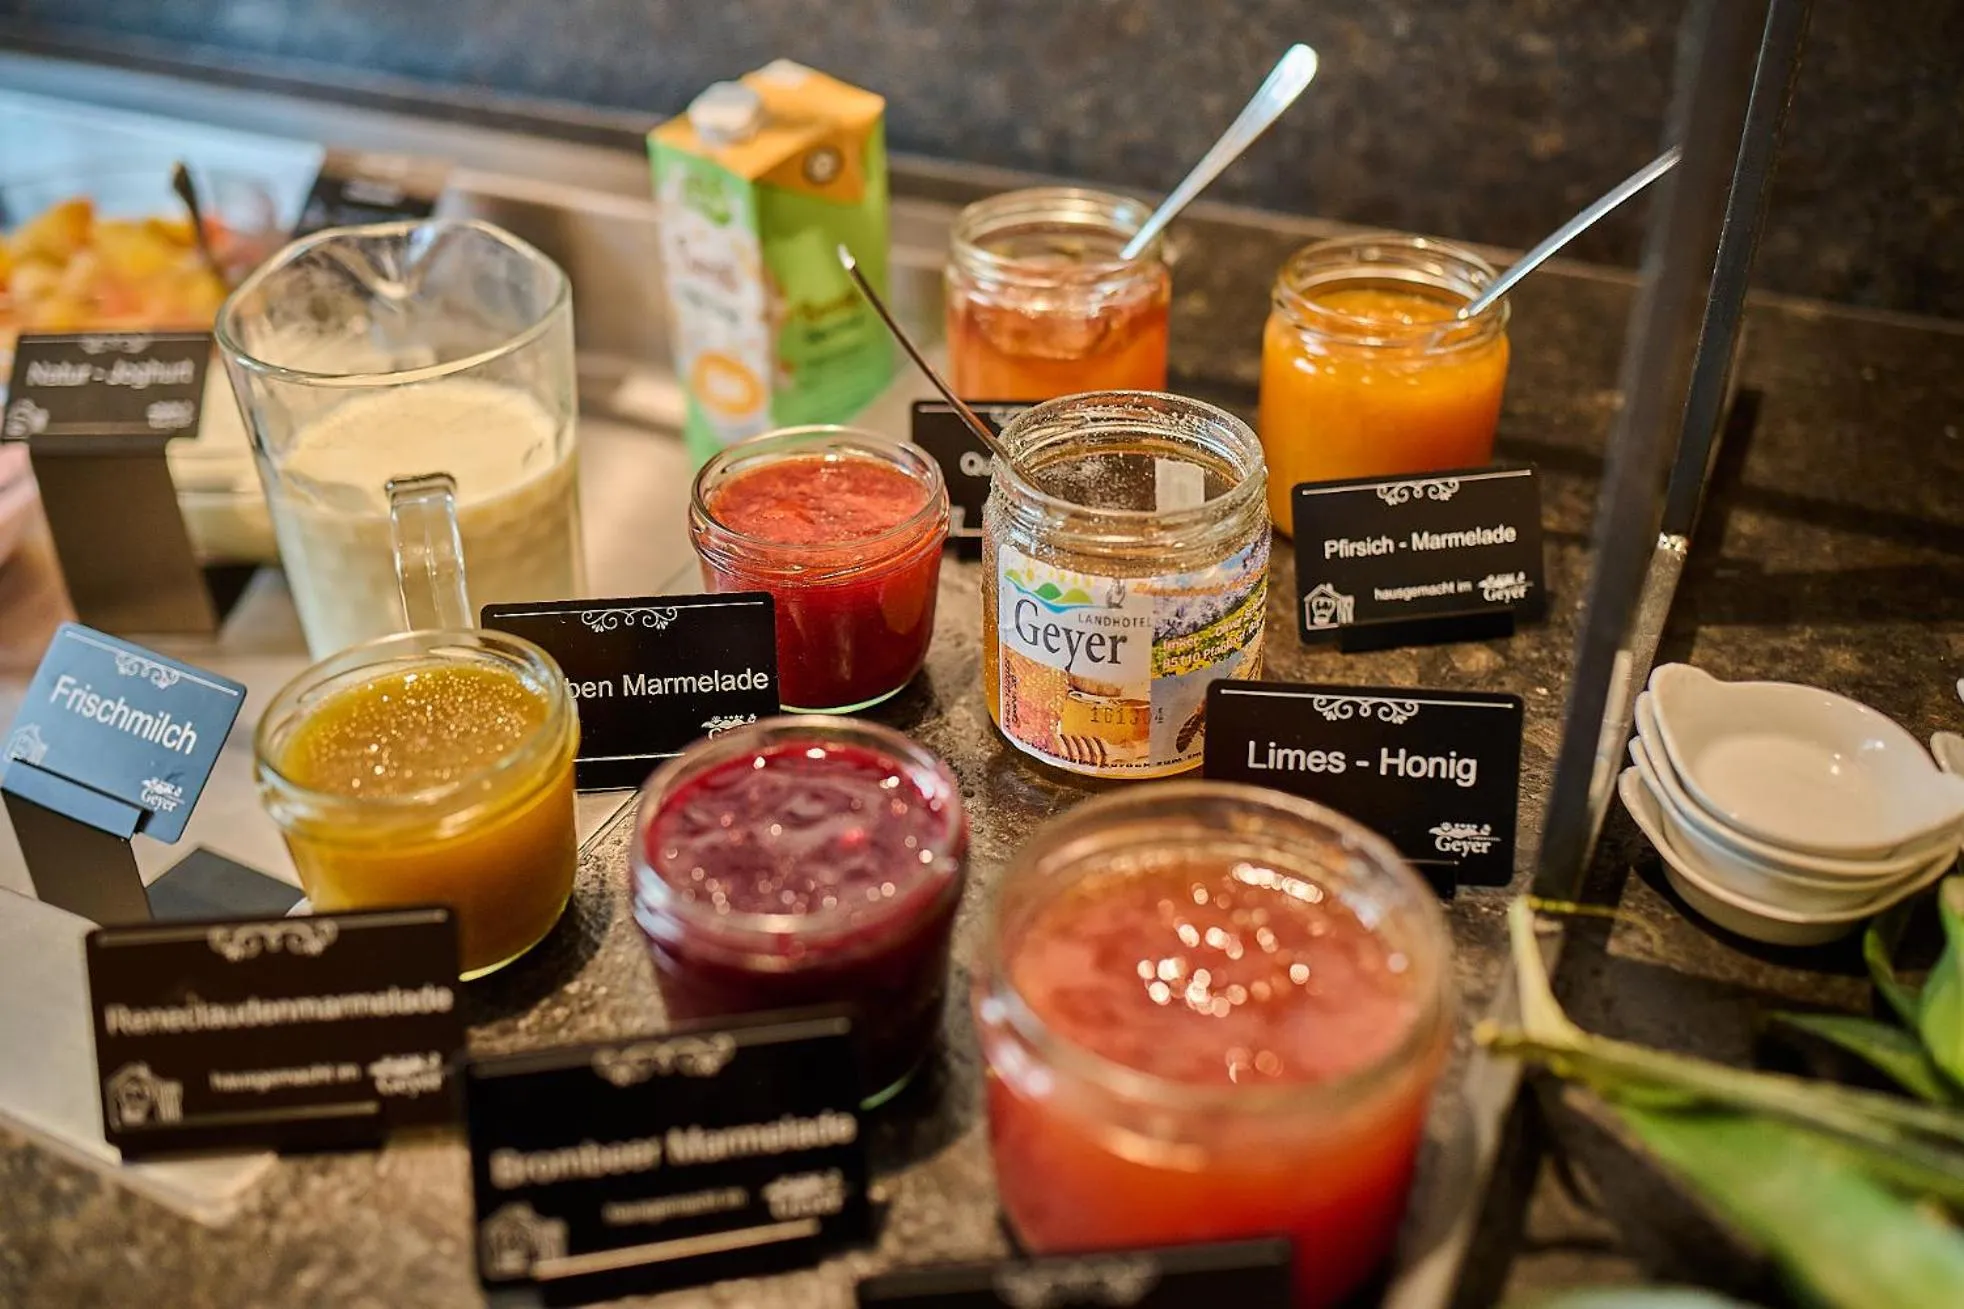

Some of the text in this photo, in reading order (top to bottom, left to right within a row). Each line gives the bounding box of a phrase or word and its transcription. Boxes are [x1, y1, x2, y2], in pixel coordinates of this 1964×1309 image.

[1323, 535, 1395, 560] Pfirsich
[1411, 524, 1517, 551] Marmelade
[1015, 599, 1128, 673] Geyer
[1078, 614, 1152, 628] LANDHOTEL
[622, 668, 769, 697] Marmelade
[50, 674, 198, 755] Frischmilch
[1247, 740, 1346, 774] Limes
[1379, 746, 1478, 788] Honig
[1435, 836, 1493, 858] Geyer
